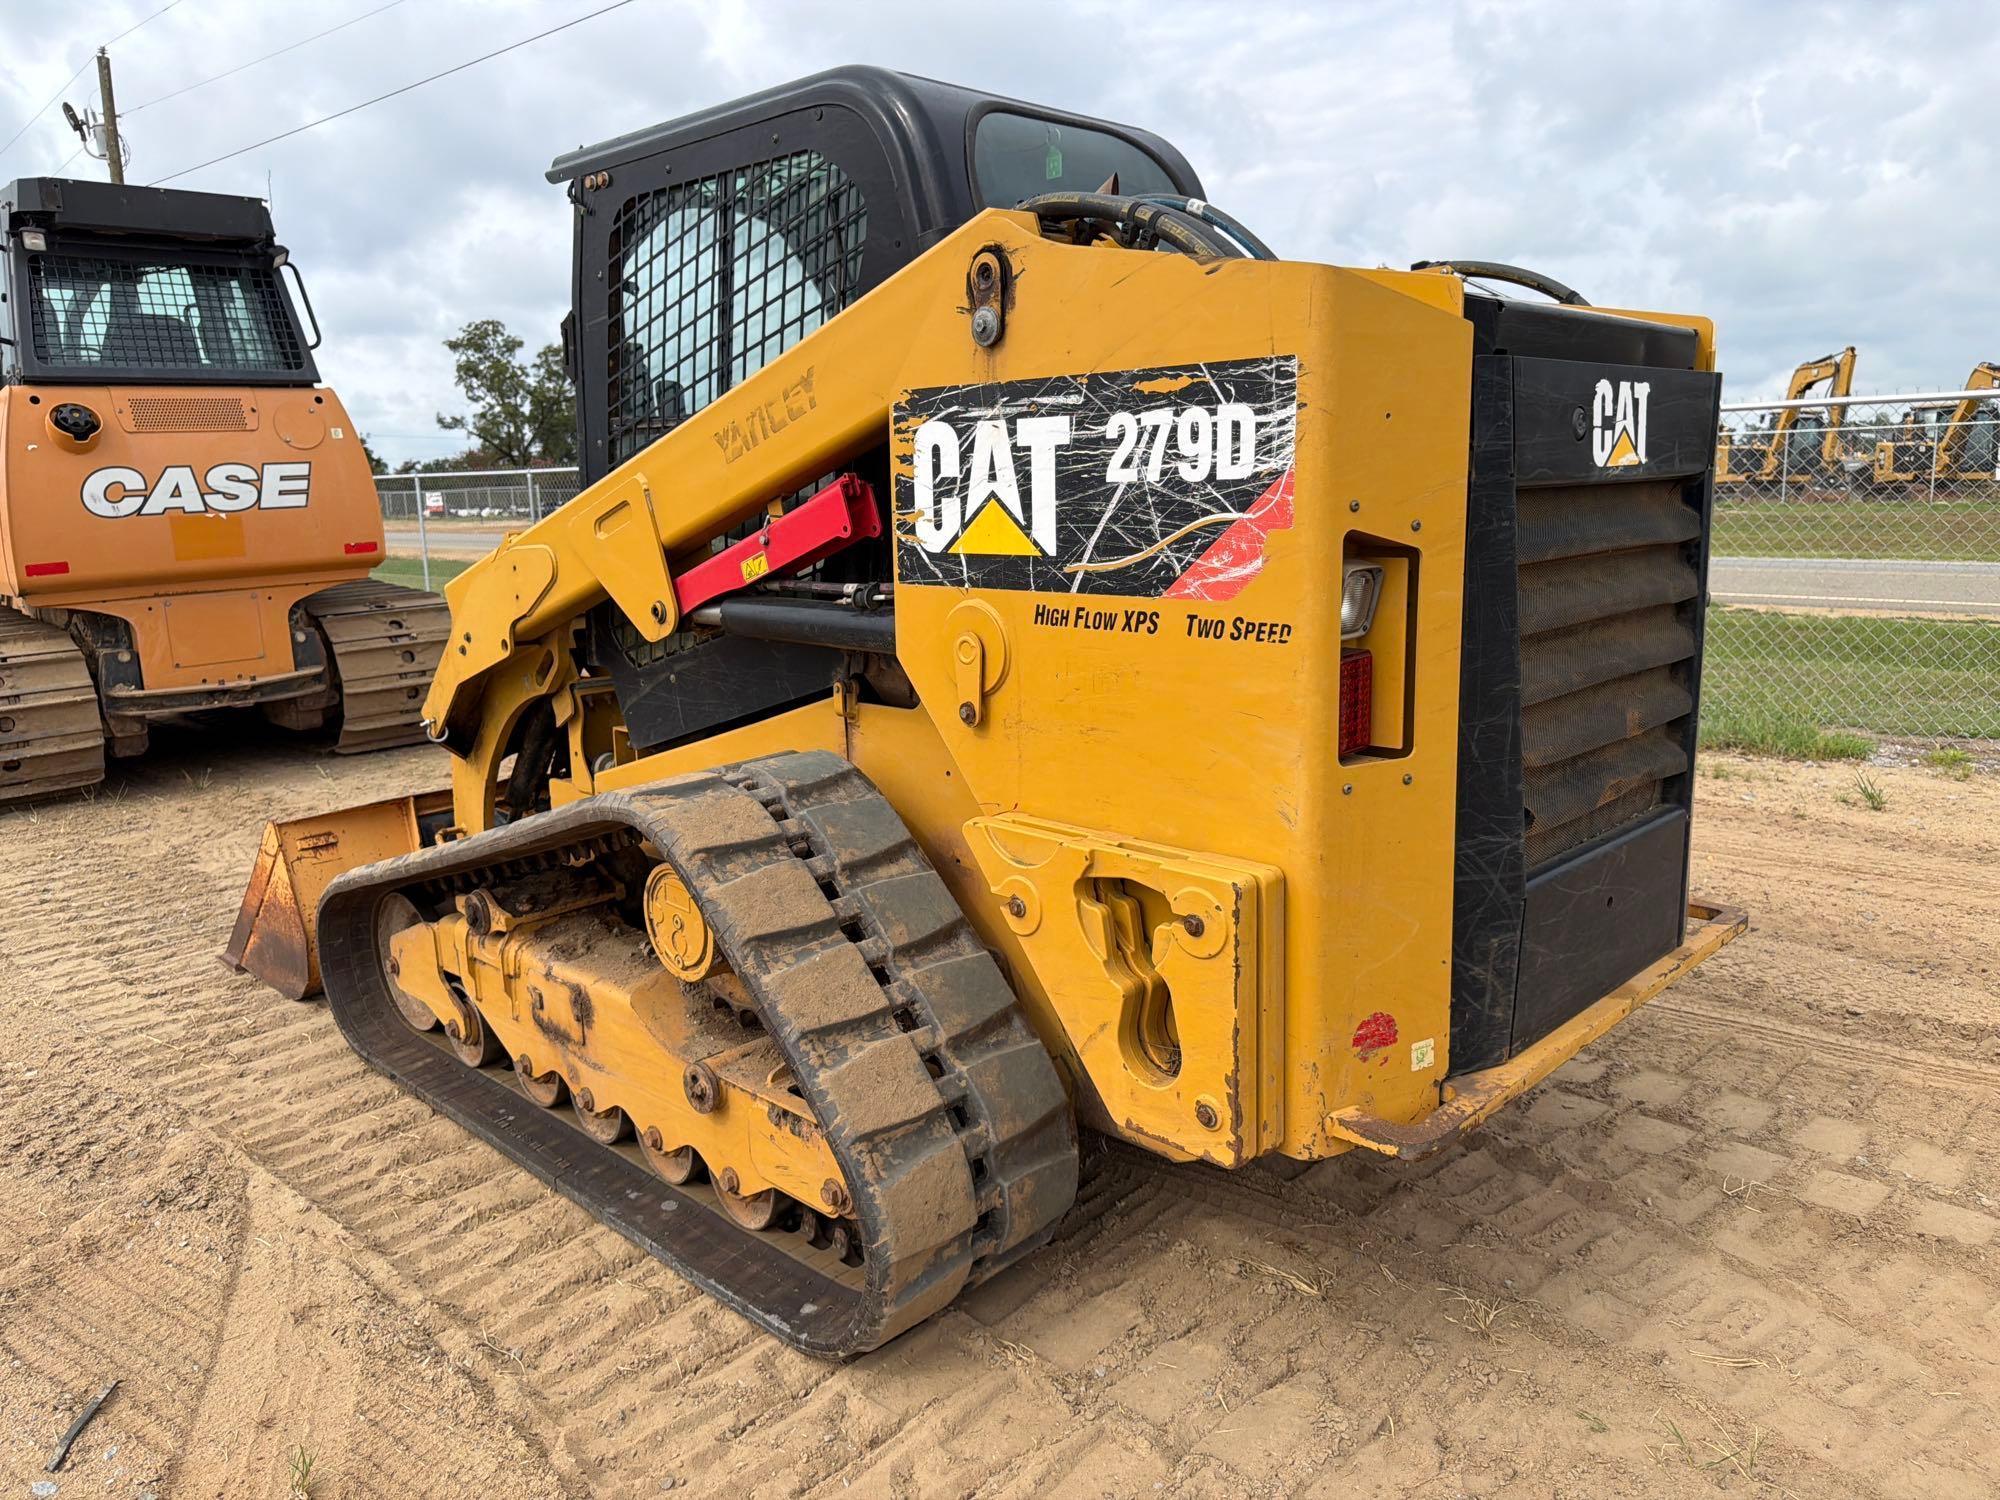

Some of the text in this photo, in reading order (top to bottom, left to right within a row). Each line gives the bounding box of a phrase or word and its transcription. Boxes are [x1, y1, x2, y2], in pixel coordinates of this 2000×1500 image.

[1592, 379, 1651, 467] CAT
[80, 461, 311, 518] CASE
[913, 403, 1256, 557] CAT 279D
[1121, 609, 1160, 635] XPS
